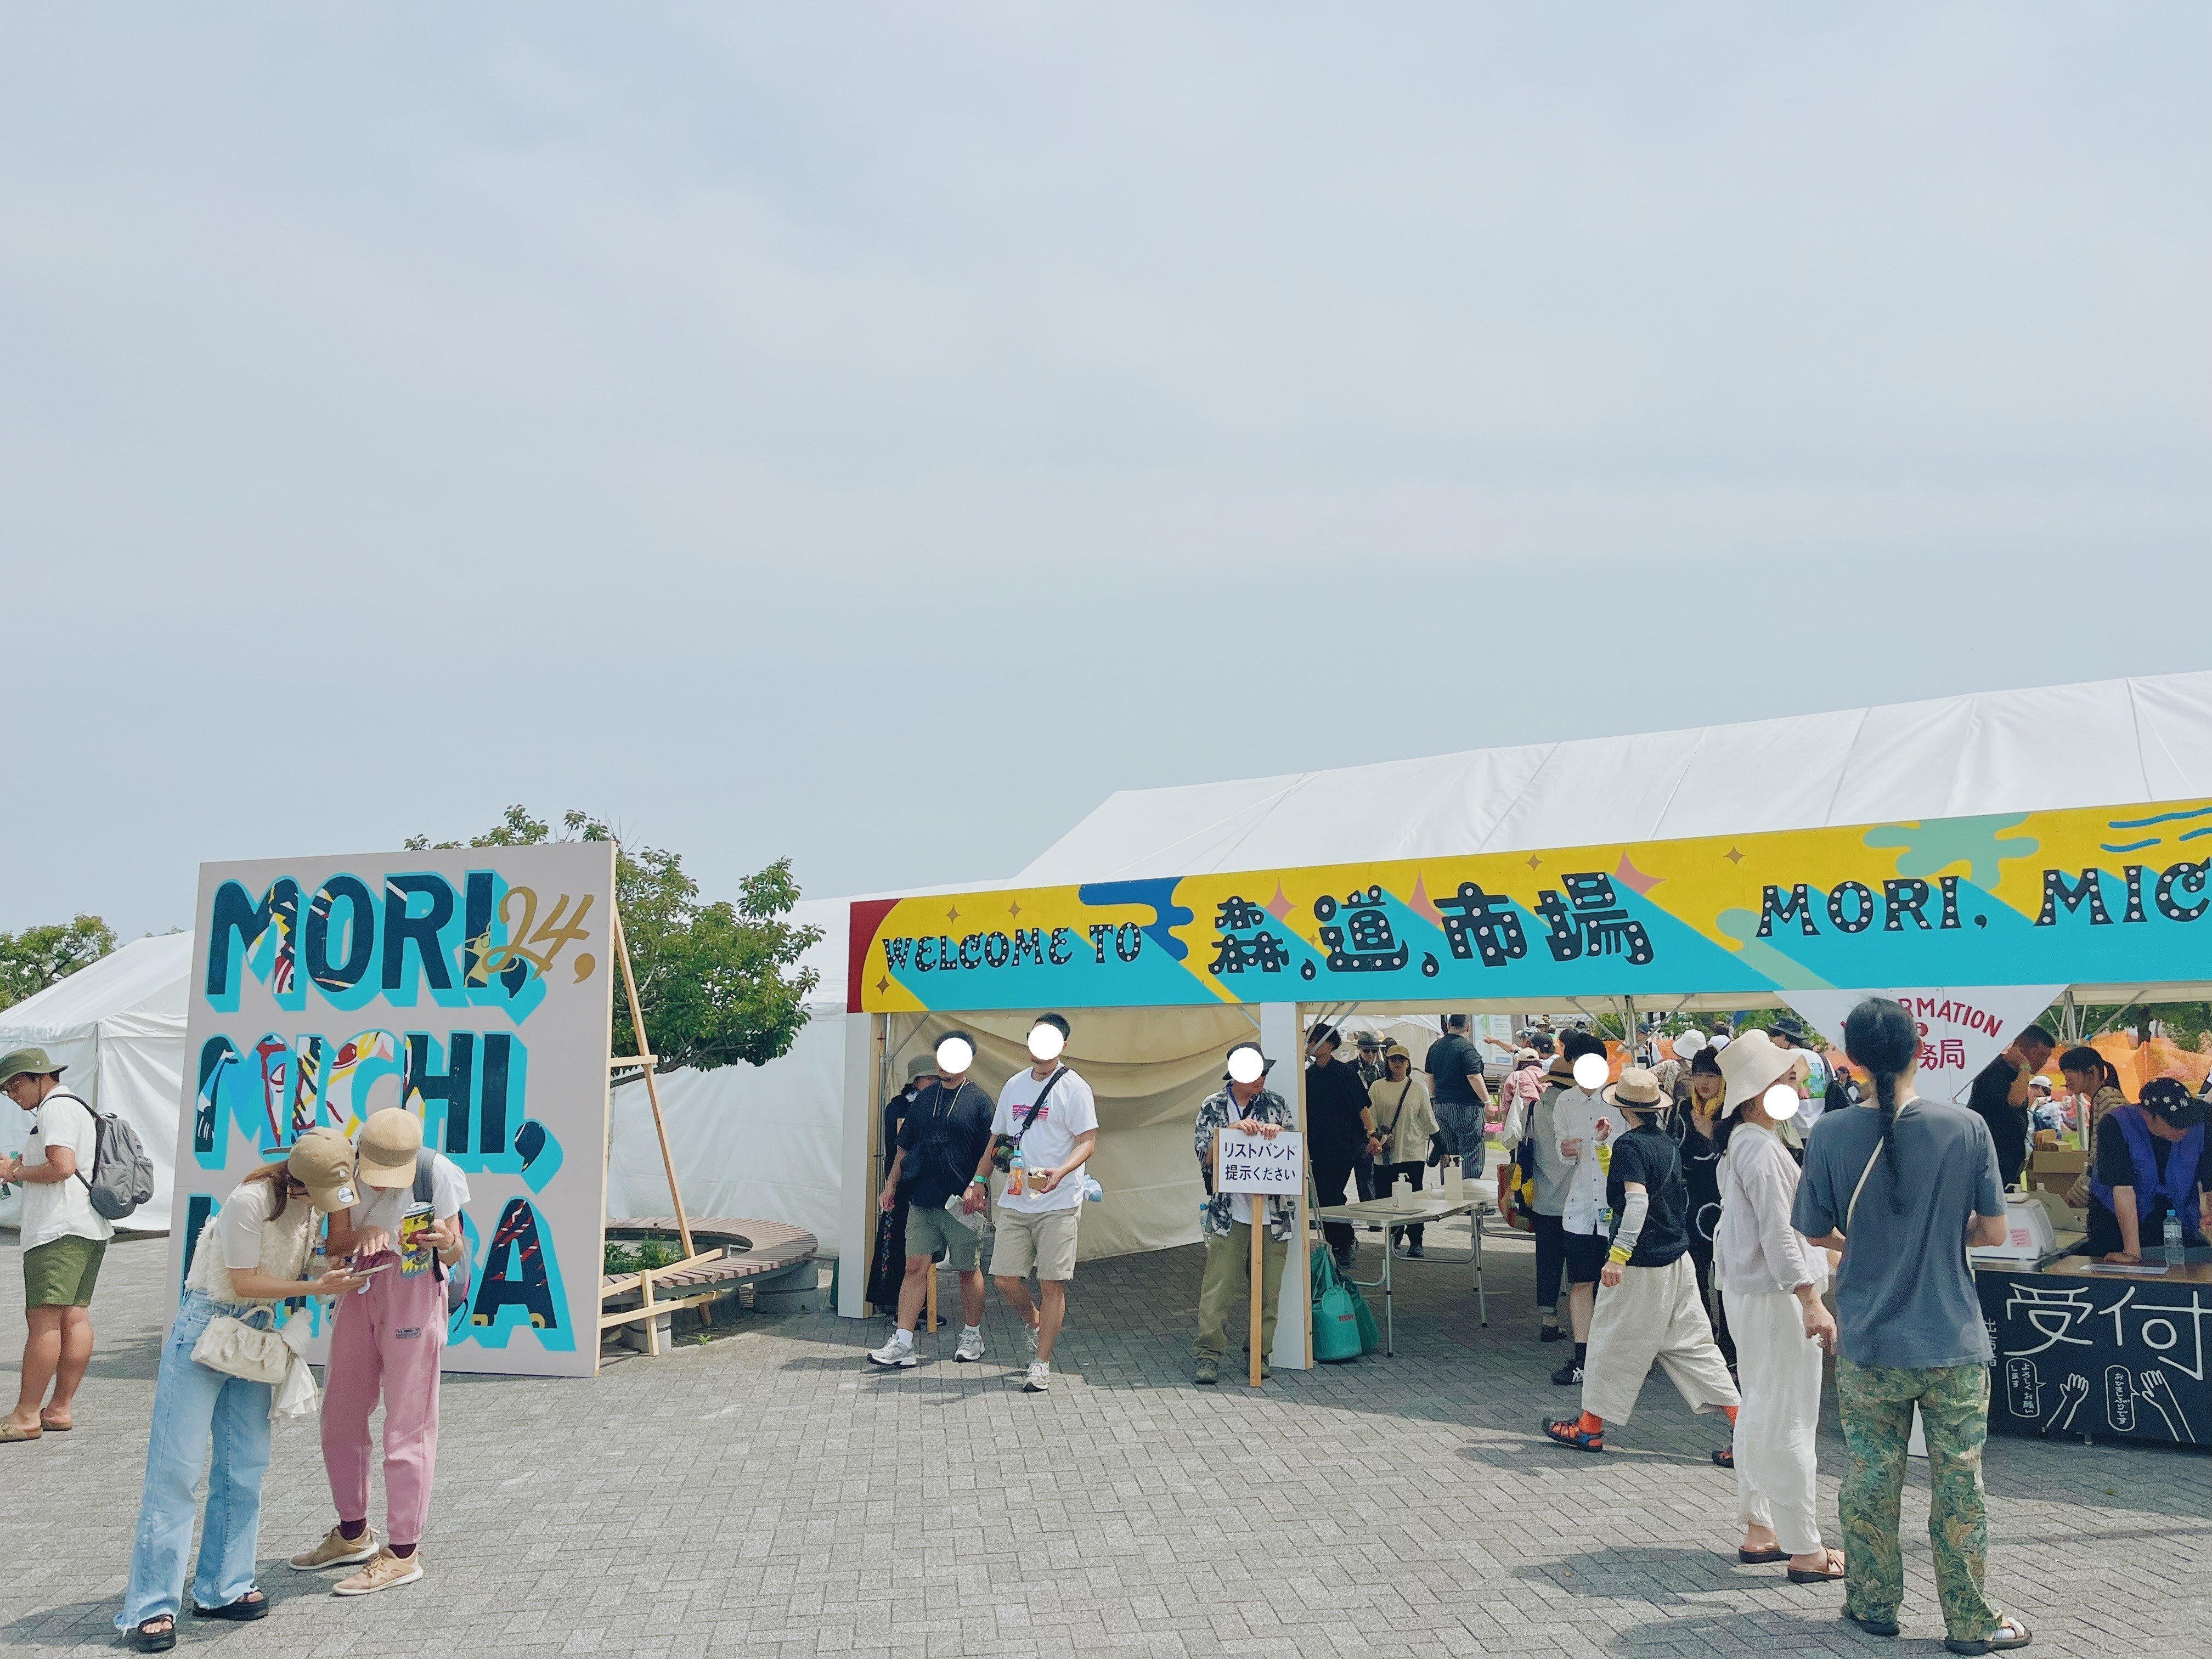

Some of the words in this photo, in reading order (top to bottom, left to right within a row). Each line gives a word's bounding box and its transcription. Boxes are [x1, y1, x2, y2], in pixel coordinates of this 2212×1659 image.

[1756, 876, 1988, 937] MORI,
[206, 872, 527, 1002] MORI,
[882, 927, 1073, 973] WELCOME
[1089, 922, 1142, 964] TO
[1224, 1142, 1297, 1160] リストバンド
[1224, 1164, 1296, 1181] 提示ください
[2004, 1282, 2212, 1380] 受付
[2010, 1364, 2019, 1388] します
[2021, 1362, 2034, 1414] よろしくお願い
